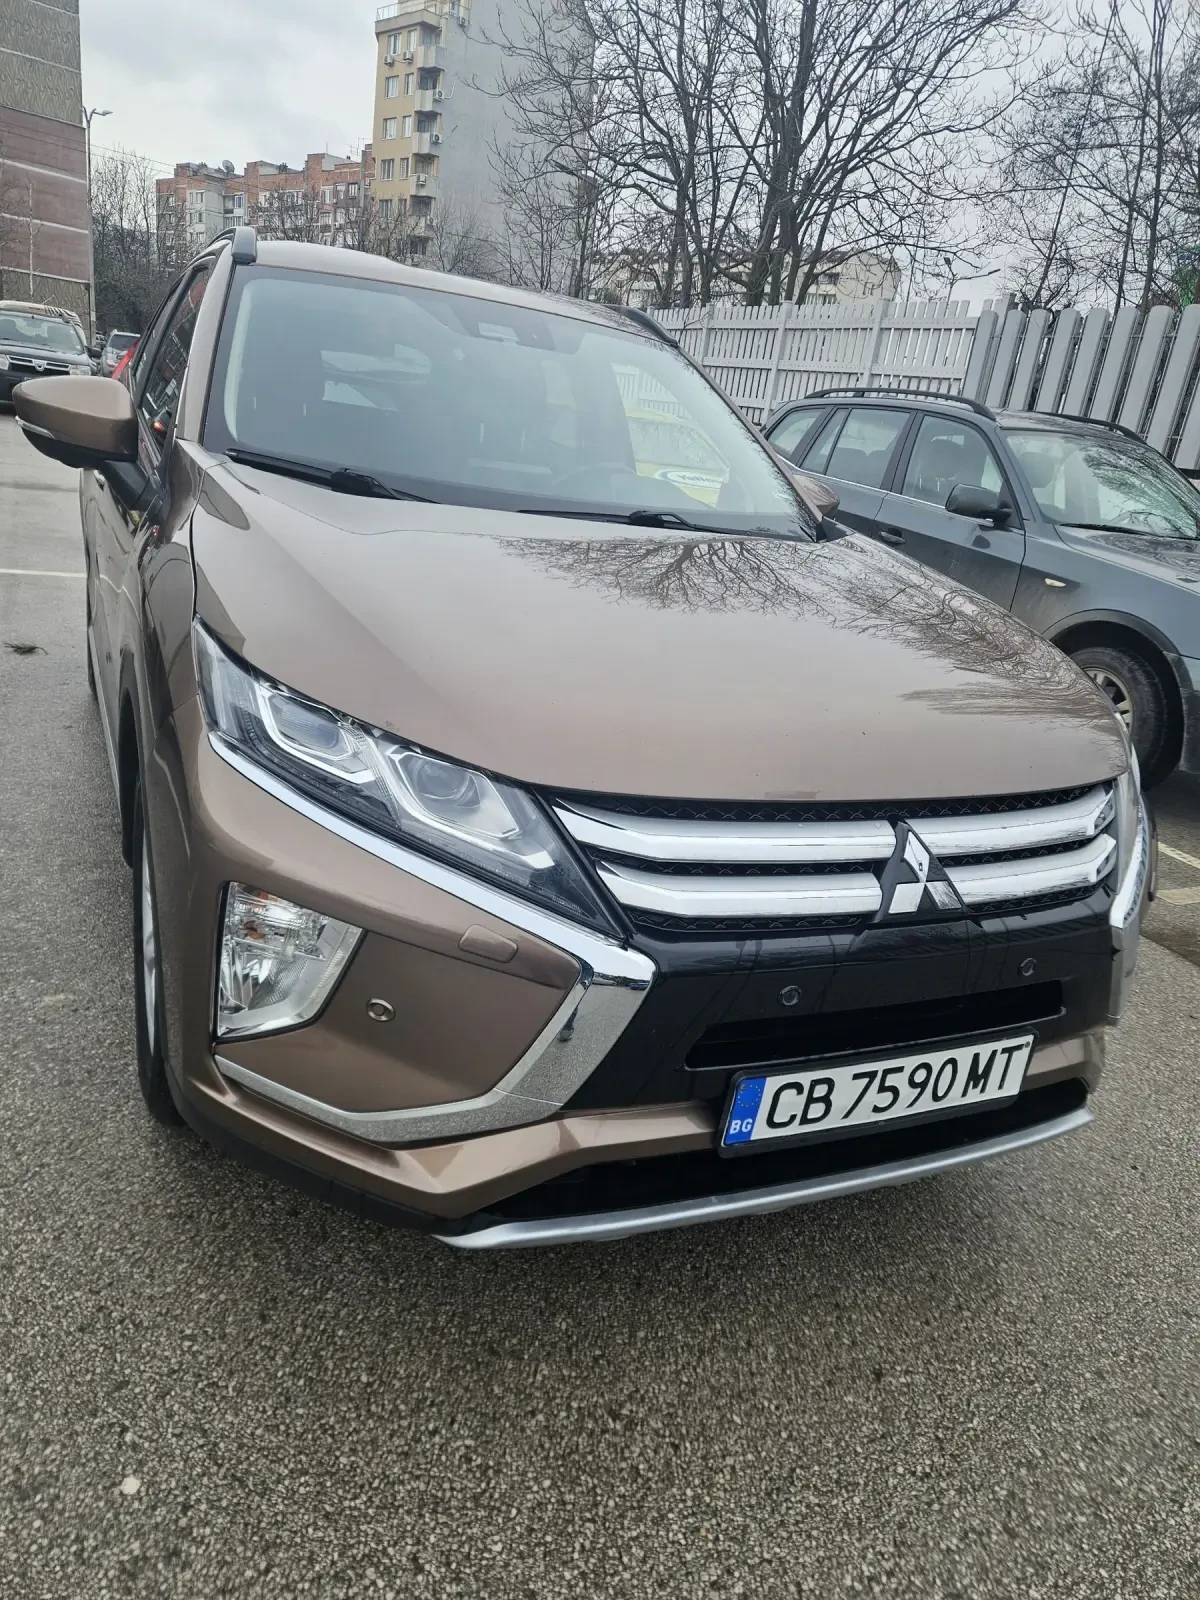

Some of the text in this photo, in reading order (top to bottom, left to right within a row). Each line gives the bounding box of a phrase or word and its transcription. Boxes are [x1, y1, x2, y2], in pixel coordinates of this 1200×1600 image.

[766, 1044, 1024, 1130] CB 7590 MT
[729, 1119, 753, 1134] BG
